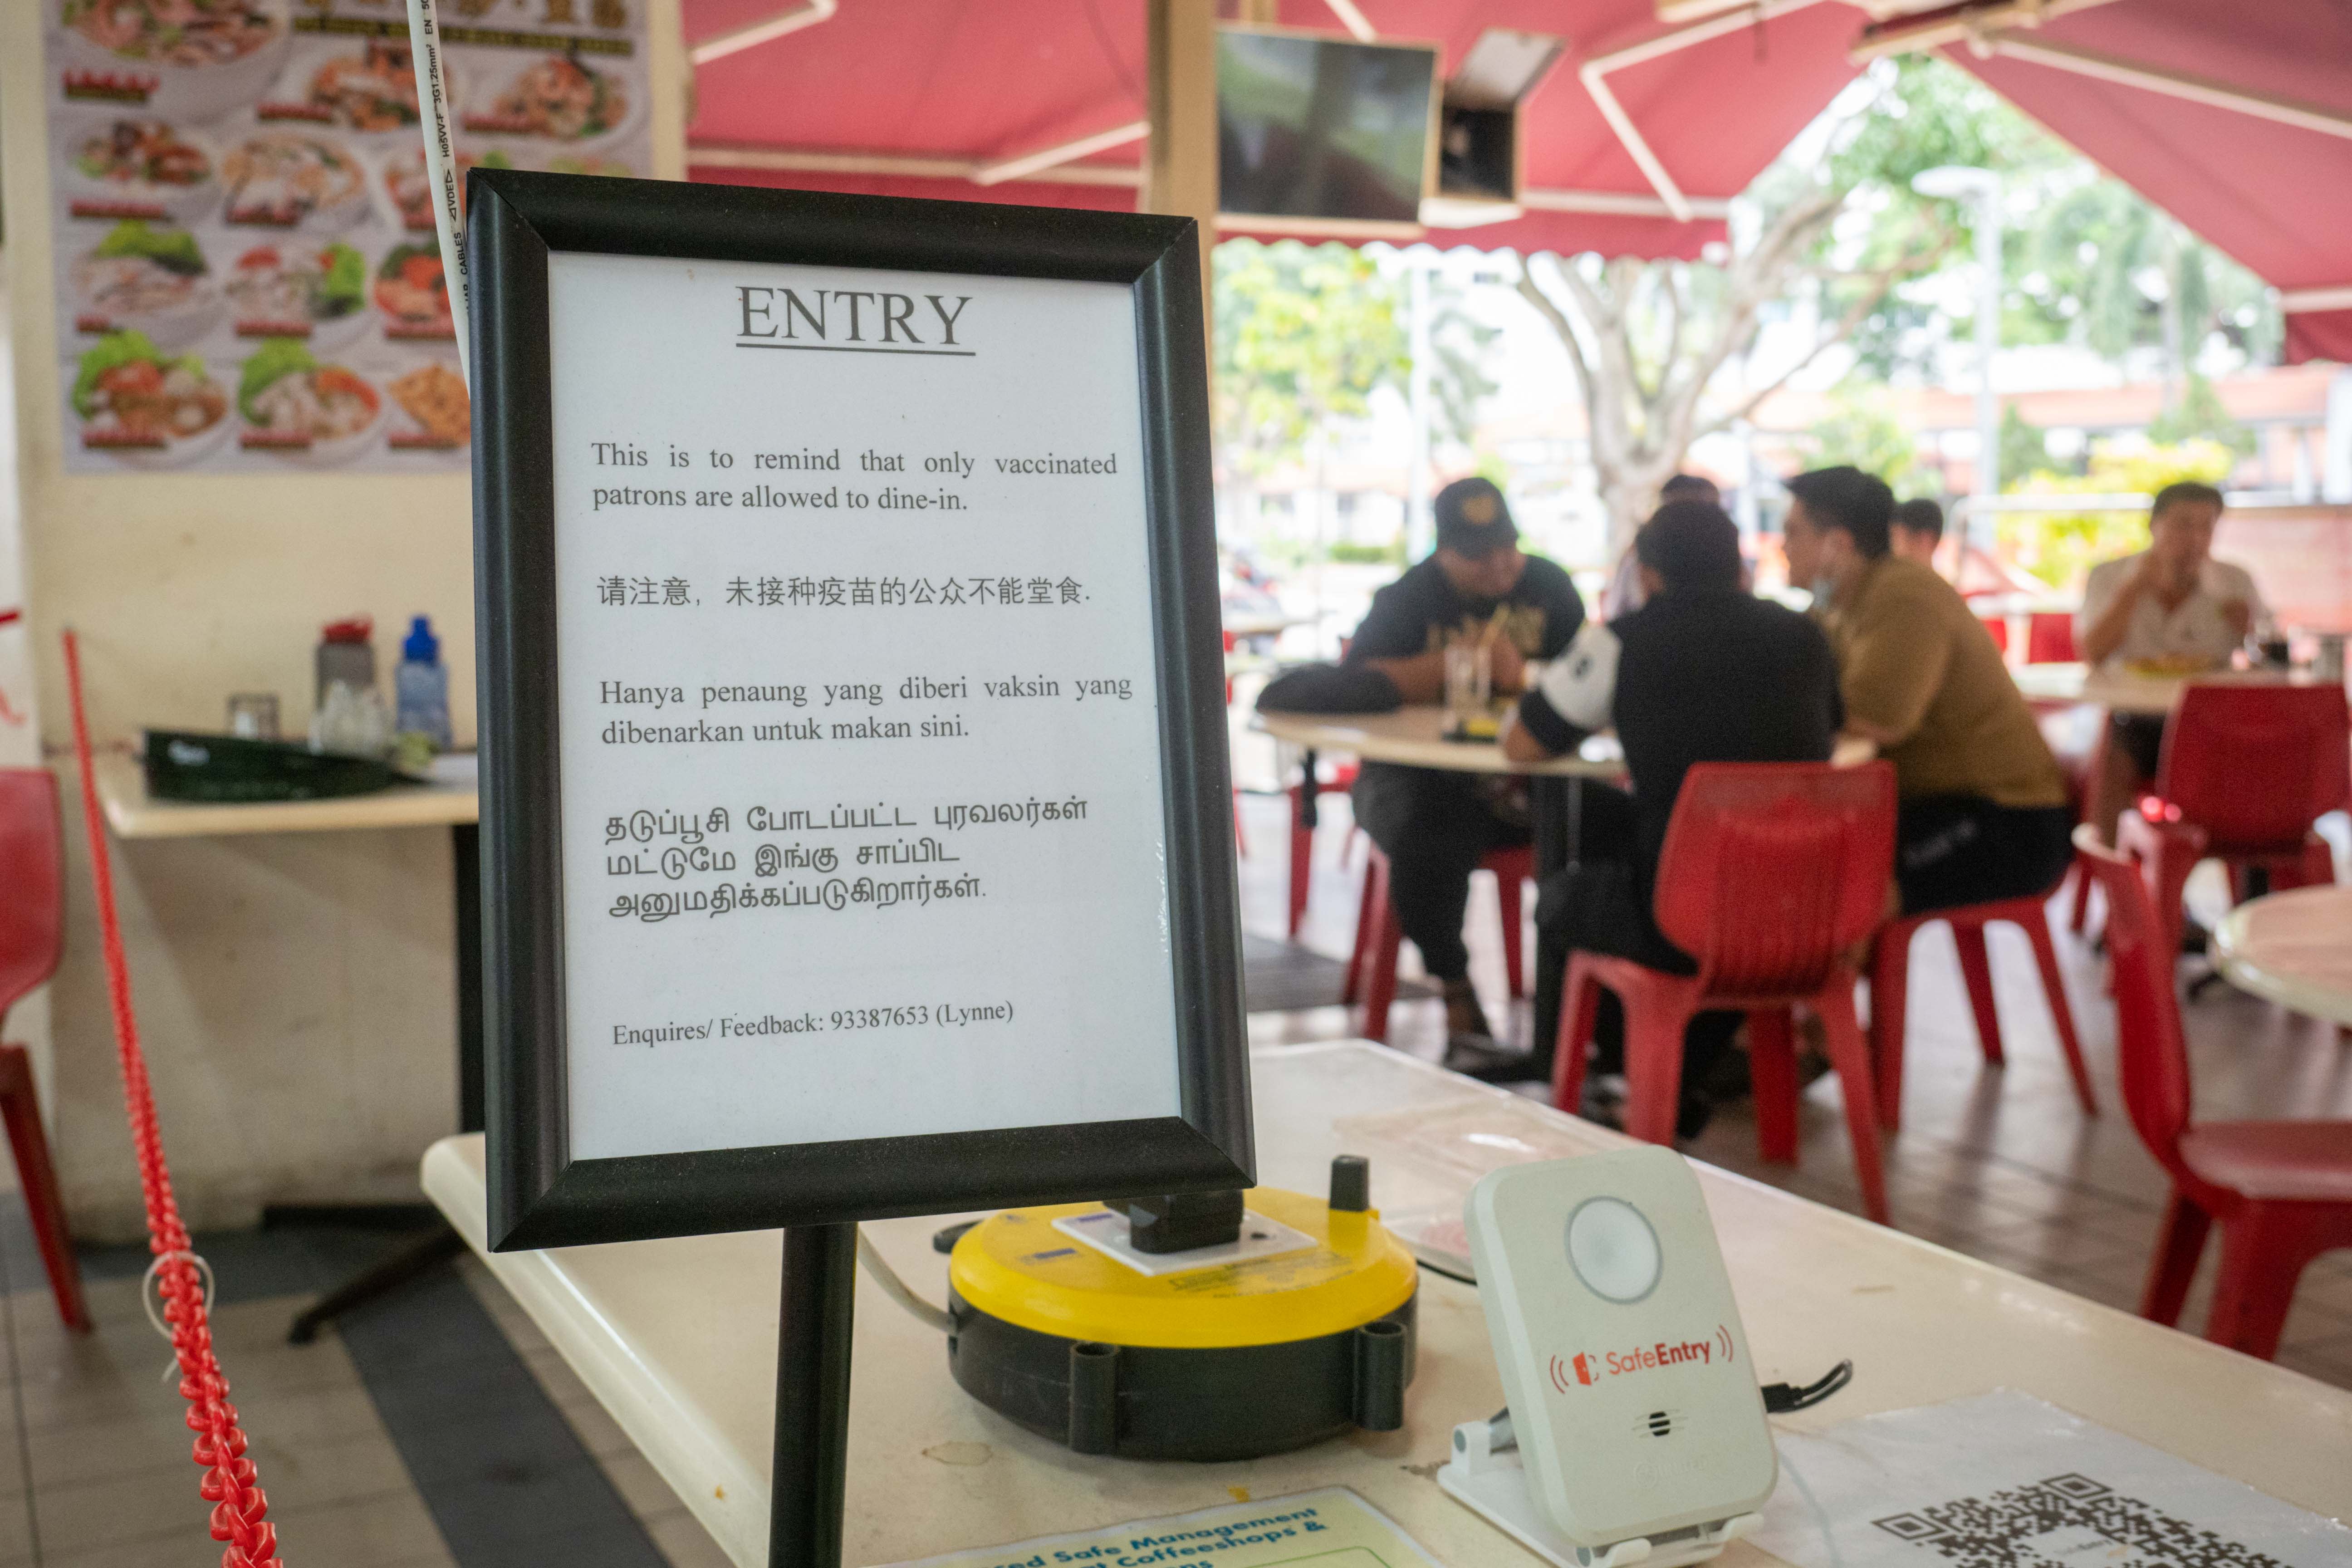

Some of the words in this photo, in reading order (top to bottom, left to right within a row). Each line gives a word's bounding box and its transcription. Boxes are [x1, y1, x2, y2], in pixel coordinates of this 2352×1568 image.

[424, 20, 433, 34] EN
[454, 232, 468, 275] CABLES
[736, 287, 972, 344] ENTRY
[592, 443, 647, 467] This
[670, 445, 689, 468] is
[710, 450, 733, 468] to
[755, 448, 841, 471] remind
[860, 449, 905, 472] that
[925, 451, 975, 479] only
[995, 453, 1117, 474] vaccinated
[593, 486, 686, 510] patrons
[696, 491, 733, 507] are
[742, 485, 839, 509] allowed
[845, 490, 869, 509] to
[878, 487, 967, 510] dine-in.
[600, 681, 685, 709] Hanya
[701, 686, 807, 709] penaung
[824, 685, 883, 706] yang
[900, 676, 967, 699] diberi
[984, 674, 1060, 700] vaksin
[1075, 680, 1132, 701] yang
[602, 720, 744, 744] dibenarkan
[752, 717, 823, 741] untuk
[830, 716, 911, 739] makan
[921, 714, 969, 737] sini.
[605, 807, 729, 845] தடுப்பூசி
[747, 802, 916, 832] போடப்பட்ட
[935, 795, 1087, 831] புரவலர்கள்
[608, 847, 736, 880] மட்டுமே
[755, 843, 838, 877] இங்கு
[857, 837, 960, 865] சாப்பிட
[609, 872, 986, 923] அனுமதிக்கப்படுகிறார்கள்.
[613, 1019, 713, 1048] Enquires/
[720, 1014, 823, 1038] Feedback:
[831, 1006, 928, 1030] 93387653
[936, 1001, 1013, 1027] (Lynne)
[1606, 1341, 1710, 1375] SafeEntry
[1053, 1546, 1122, 1563] Safe
[1130, 1509, 1318, 1550] Management
[1117, 1527, 1297, 1567] Coffeeshops
[1303, 1521, 1328, 1533] &
